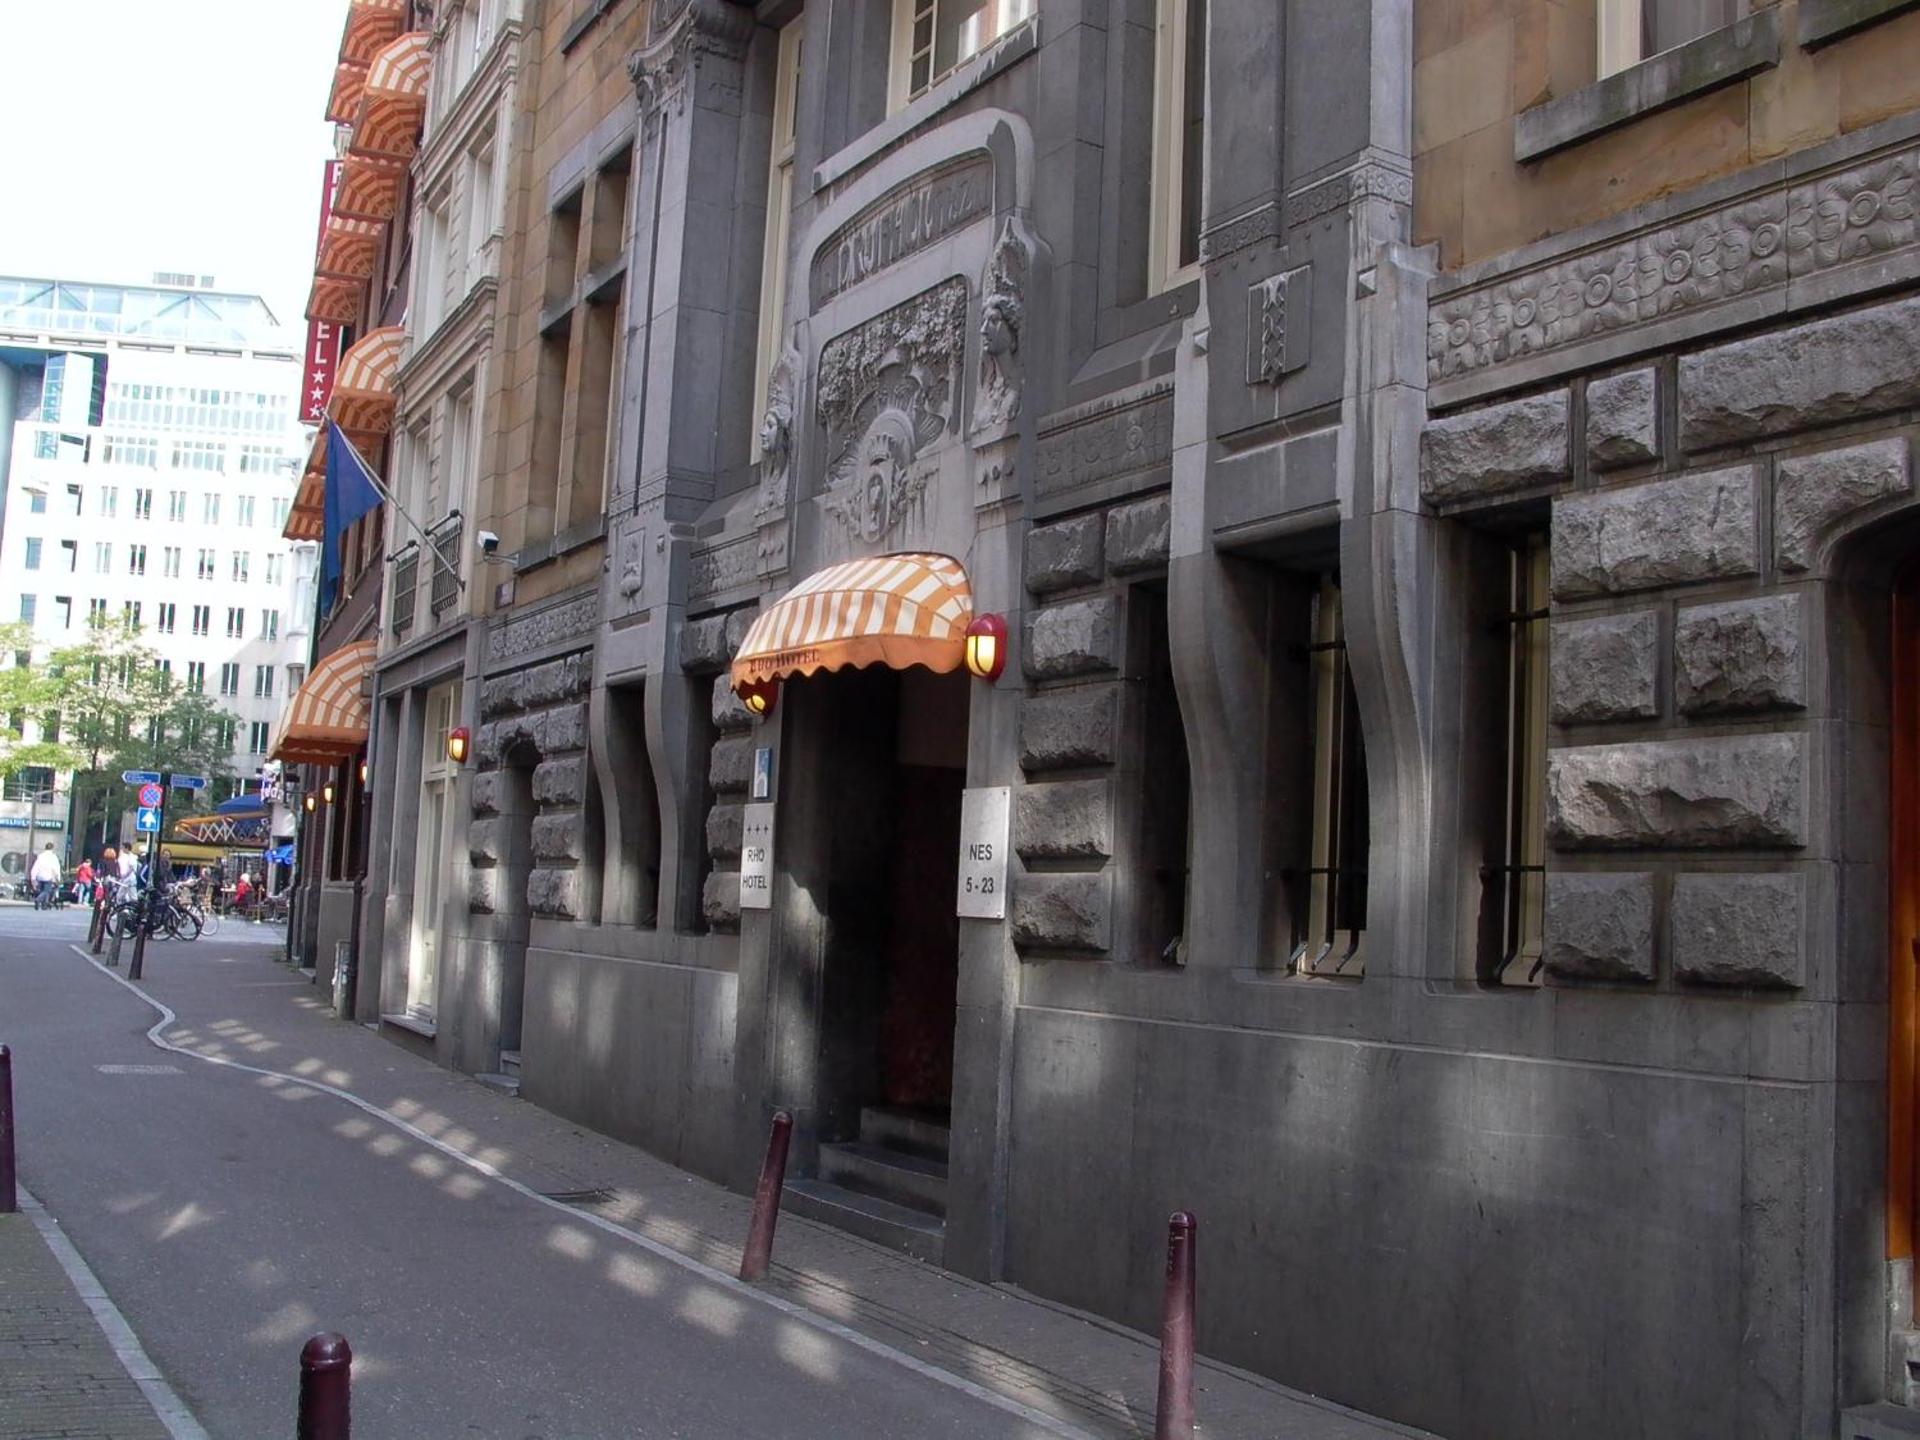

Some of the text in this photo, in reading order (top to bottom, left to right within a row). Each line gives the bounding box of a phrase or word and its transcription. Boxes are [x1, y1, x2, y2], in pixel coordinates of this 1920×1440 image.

[776, 649, 820, 668] HOTEL
[747, 848, 765, 863] RHO
[969, 844, 993, 861] NES
[741, 874, 768, 889] HOTEL
[966, 877, 973, 893] 5
[981, 877, 994, 893] 23
